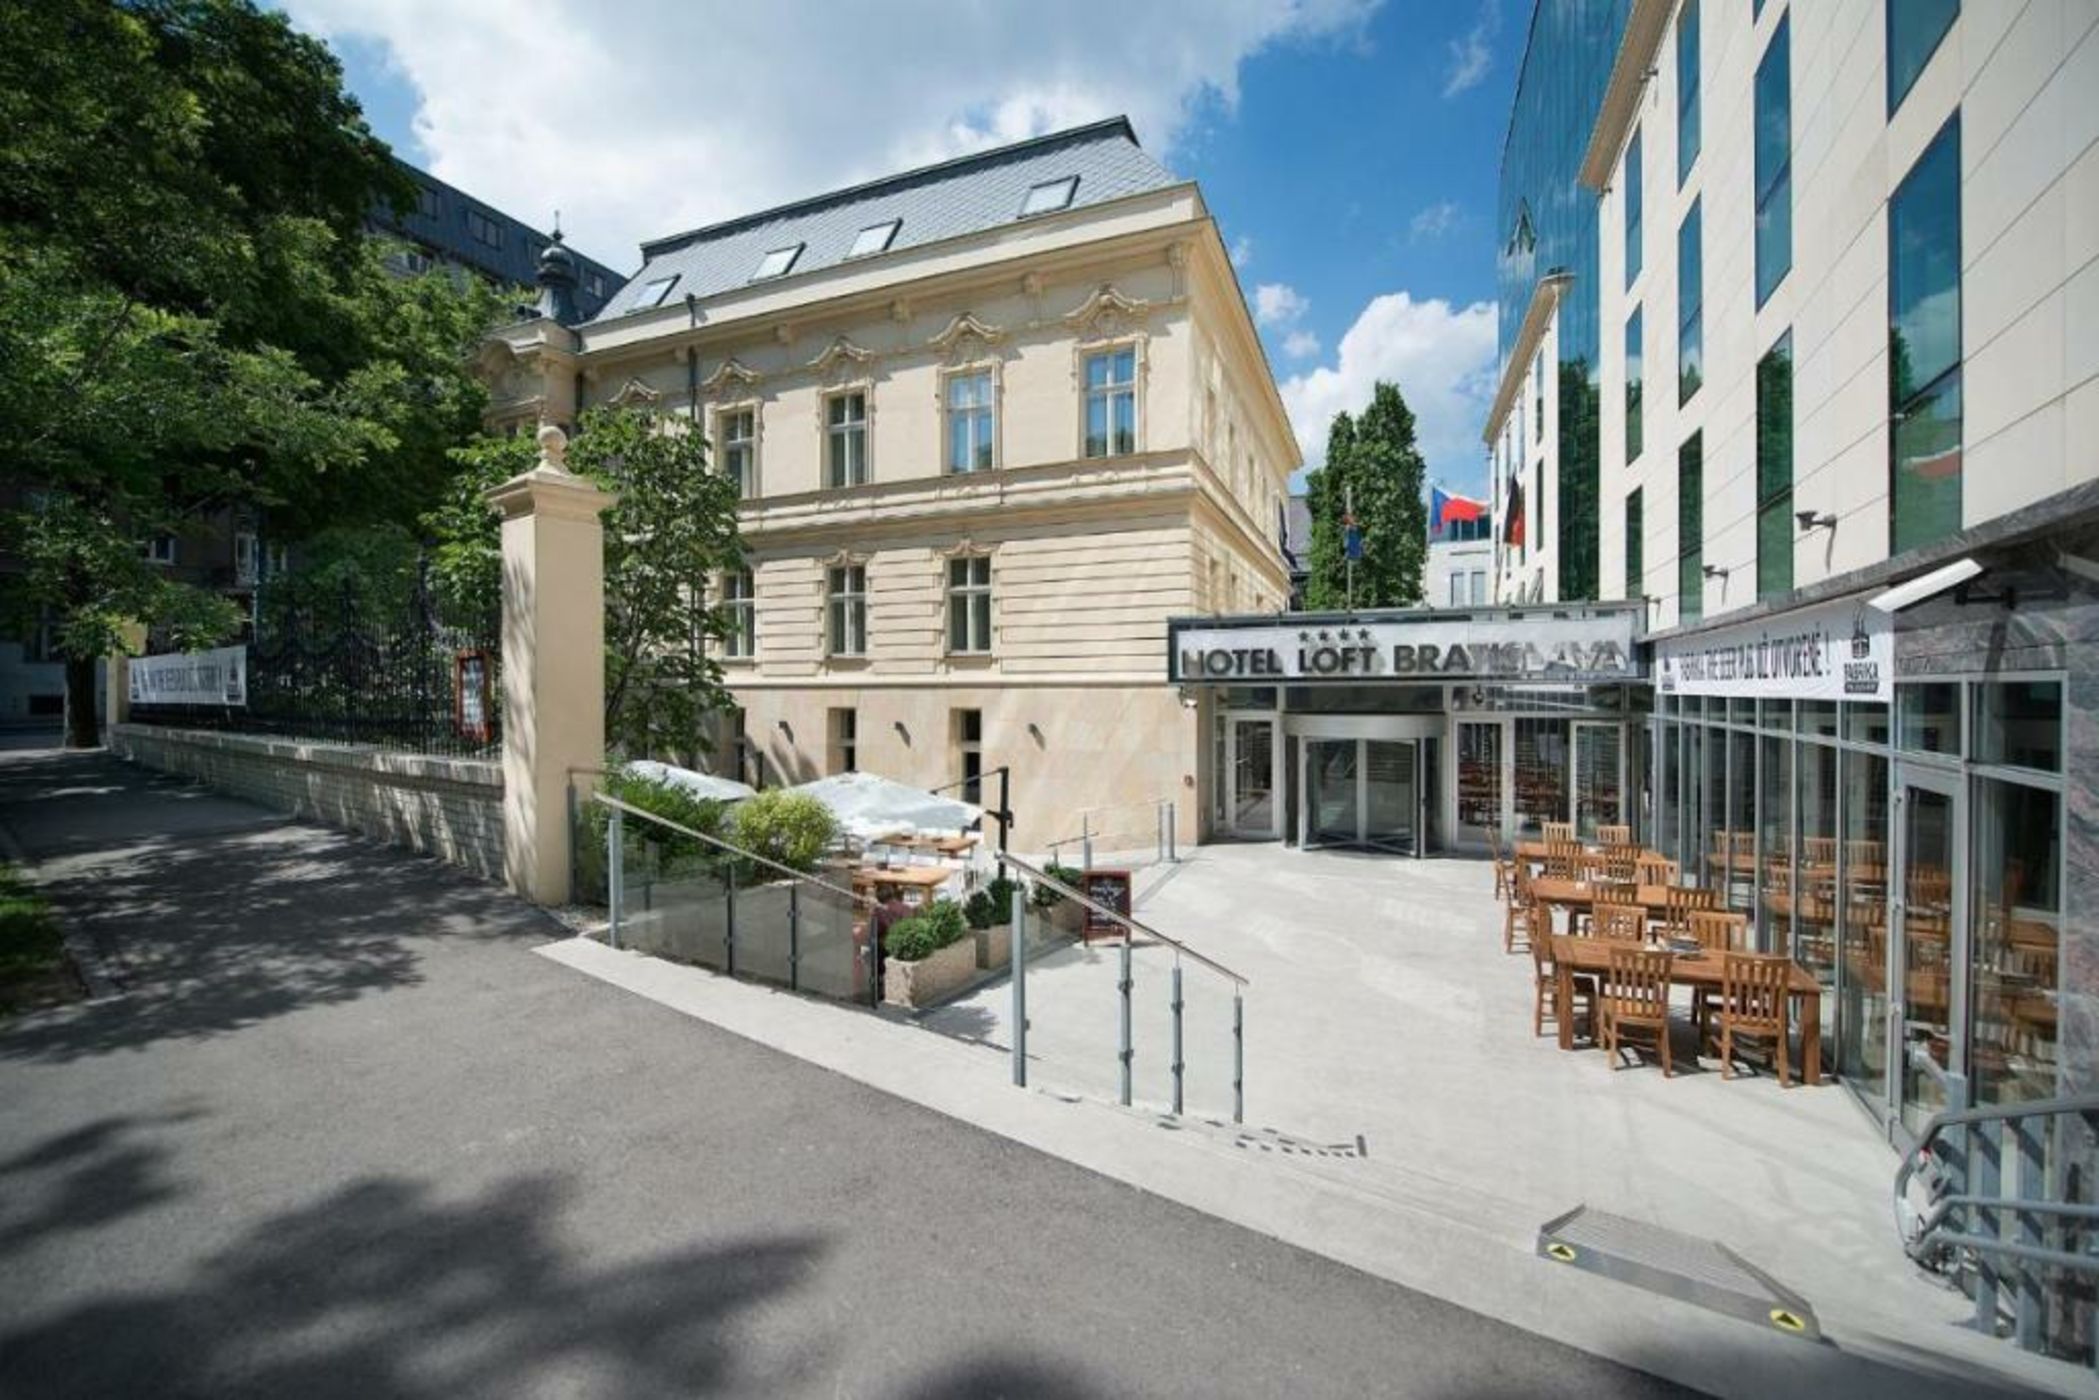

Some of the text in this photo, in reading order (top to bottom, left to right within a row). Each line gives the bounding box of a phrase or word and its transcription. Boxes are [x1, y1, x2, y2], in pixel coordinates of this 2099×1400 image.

[1182, 639, 1628, 675] HOTEL LOFT BRATISLAVA
[1844, 662, 1879, 681] FABRIKA
